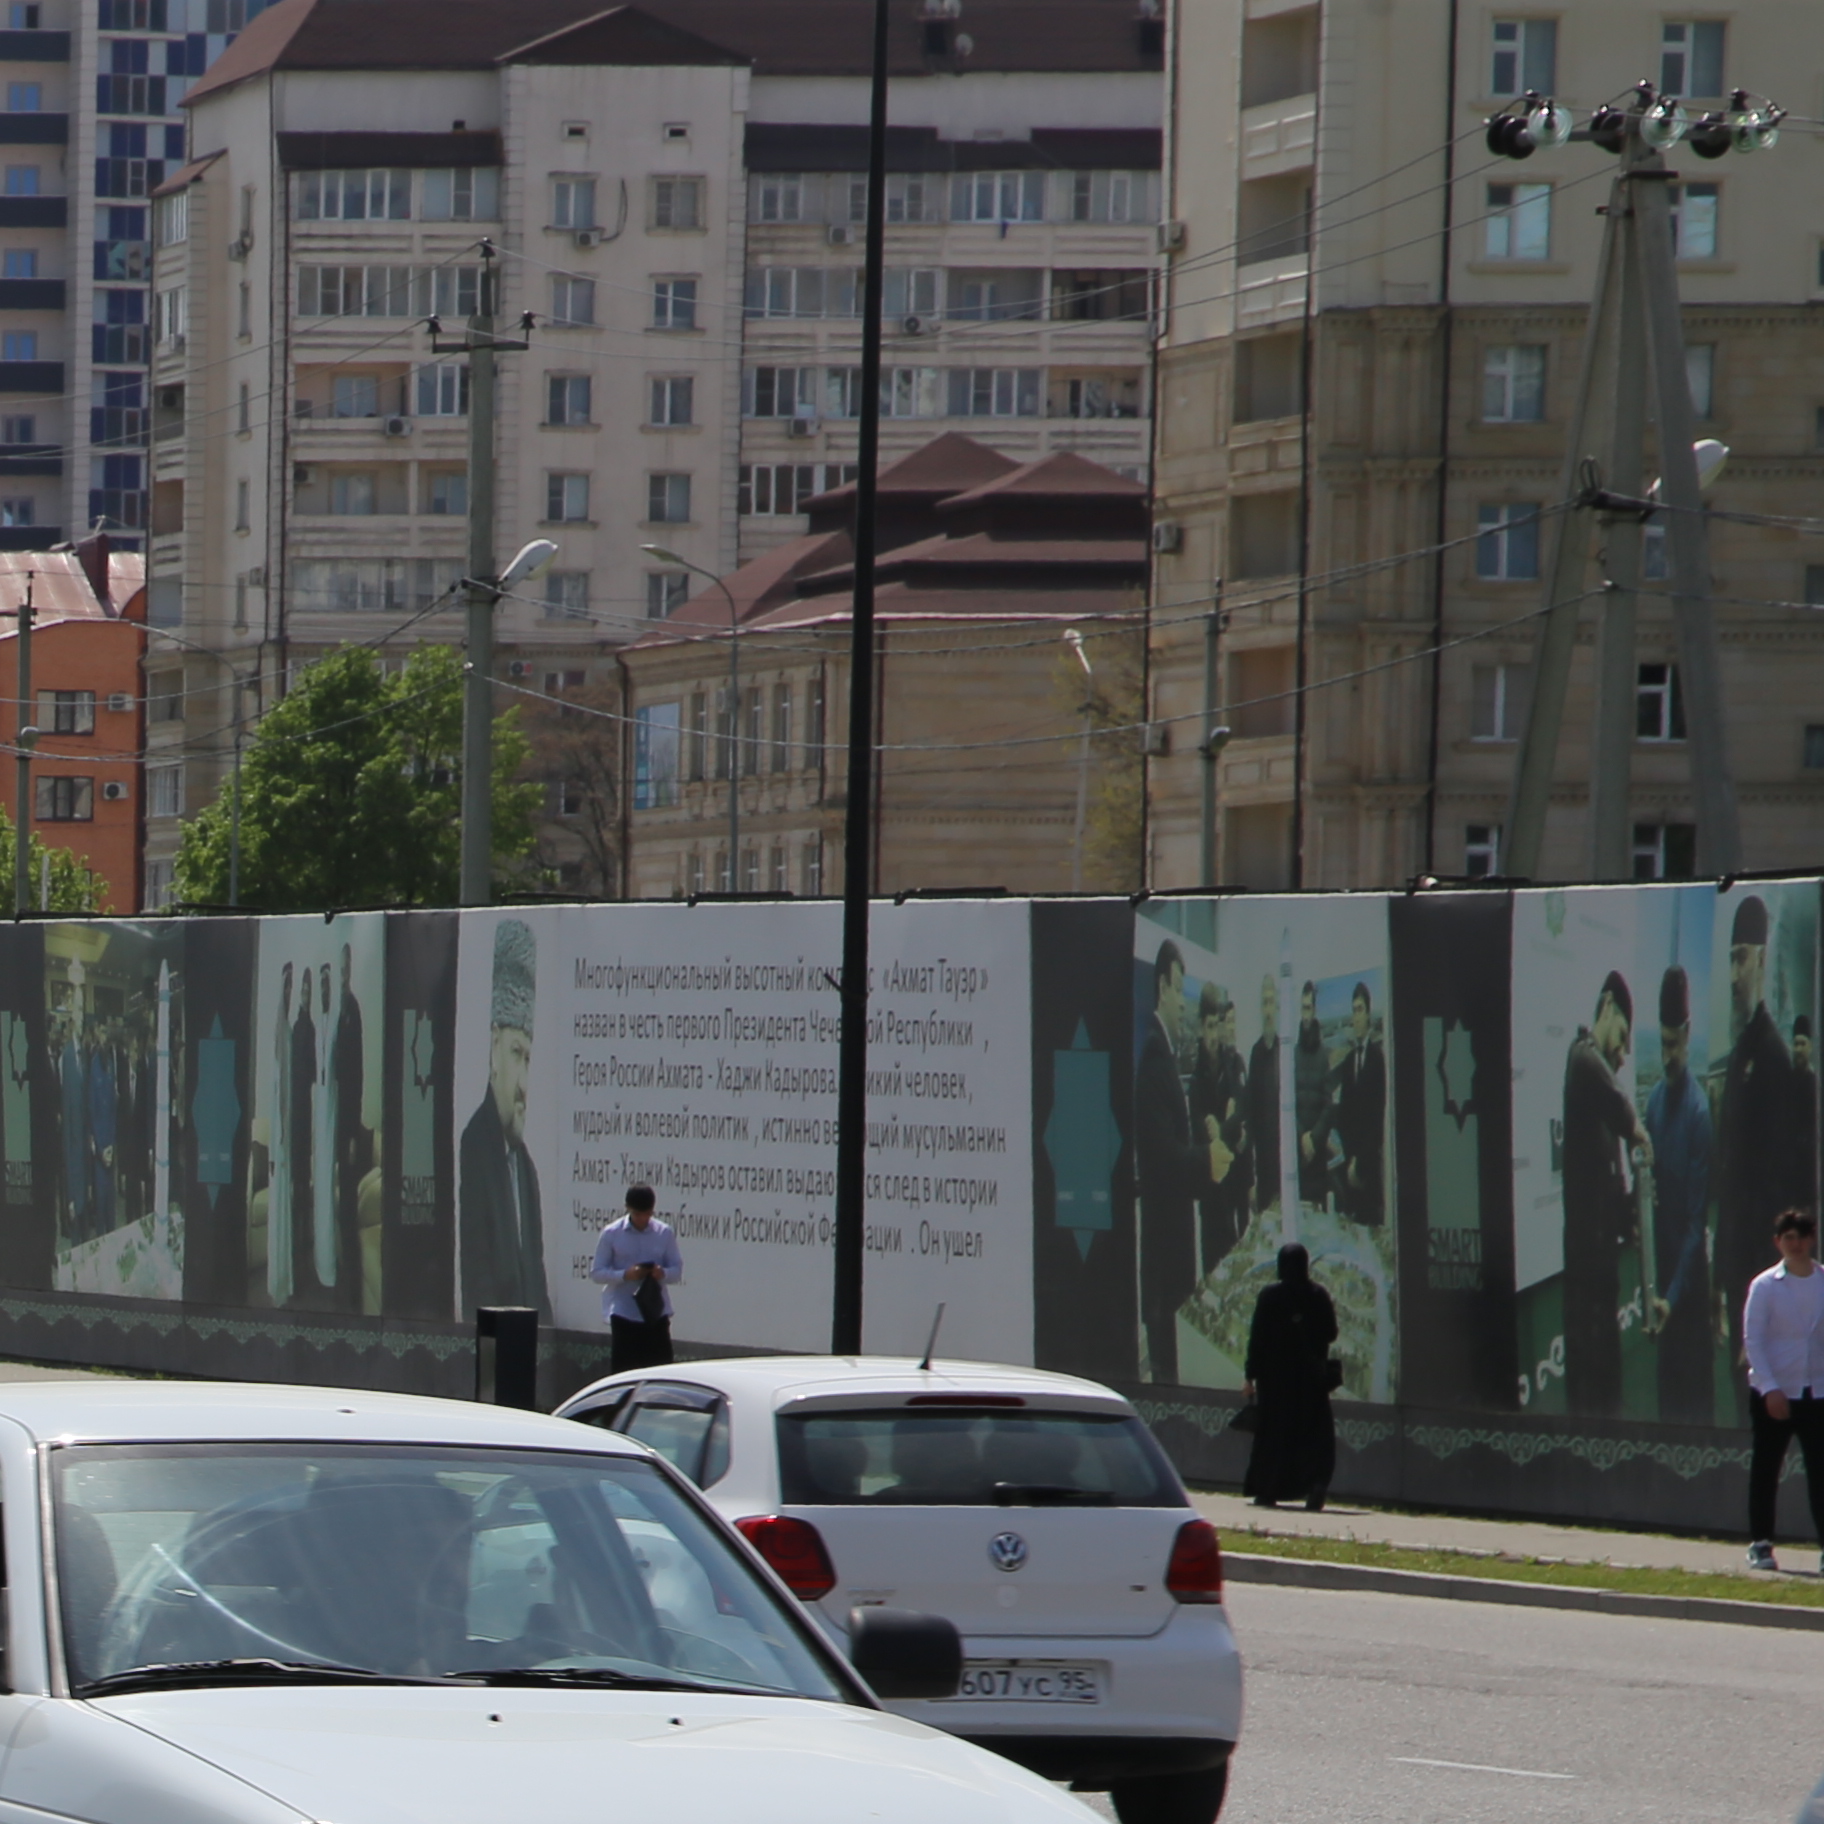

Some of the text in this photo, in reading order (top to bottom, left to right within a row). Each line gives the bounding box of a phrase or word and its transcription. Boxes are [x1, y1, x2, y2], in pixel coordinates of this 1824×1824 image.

[575, 955, 732, 997] Многофункциональный
[735, 955, 804, 992] высотный
[883, 959, 934, 994] «Ахмат
[574, 1013, 616, 1039] назван
[619, 1014, 627, 1039] в
[629, 1014, 664, 1039] честь
[667, 1014, 721, 1048] первого
[724, 1007, 806, 1049] Президента
[573, 1053, 607, 1095] Героя
[610, 1054, 654, 1088] России
[656, 1056, 703, 1089] Ахмата
[716, 1057, 762, 1098] Хаджи
[573, 1103, 622, 1142] мудрый
[624, 1110, 633, 1136] и
[636, 1104, 689, 1140] волевой
[762, 1115, 820, 1145] истинно
[903, 1123, 1007, 1159] мусульманин
[572, 1151, 610, 1184] Ахмат
[620, 1152, 663, 1188] Хаджи
[666, 1156, 725, 1197] Кадыров
[728, 1165, 783, 1194] оставил
[885, 1174, 919, 1209] след
[923, 1176, 931, 1203] в
[934, 1176, 998, 1214] истории
[722, 1215, 731, 1241] и
[734, 1207, 815, 1247] Российской
[919, 1219, 940, 1256] Он
[943, 1229, 983, 1265] ушел
[1428, 1228, 1482, 1264] SMART
[1058, 1671, 1085, 1691] 95
